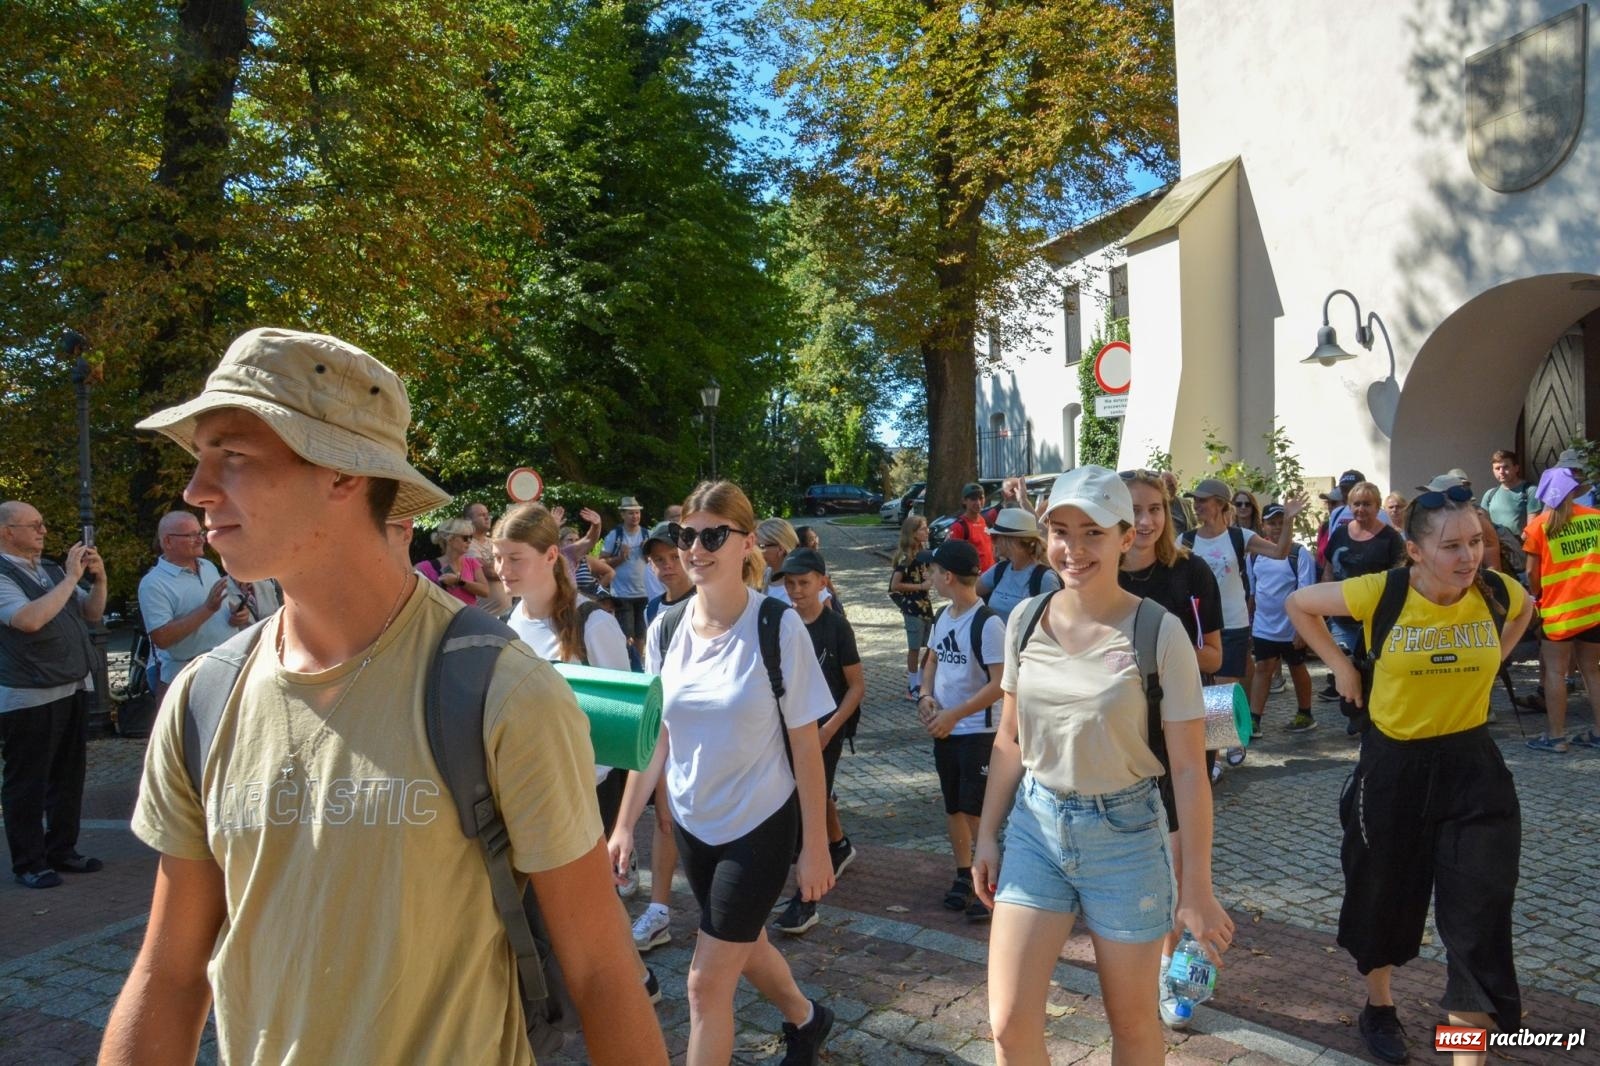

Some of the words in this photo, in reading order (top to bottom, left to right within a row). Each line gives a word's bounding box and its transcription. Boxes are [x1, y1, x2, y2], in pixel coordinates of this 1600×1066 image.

[1389, 620, 1498, 653] PHOENIX
[936, 649, 967, 665] didas
[209, 777, 440, 831] ARCASTIC
